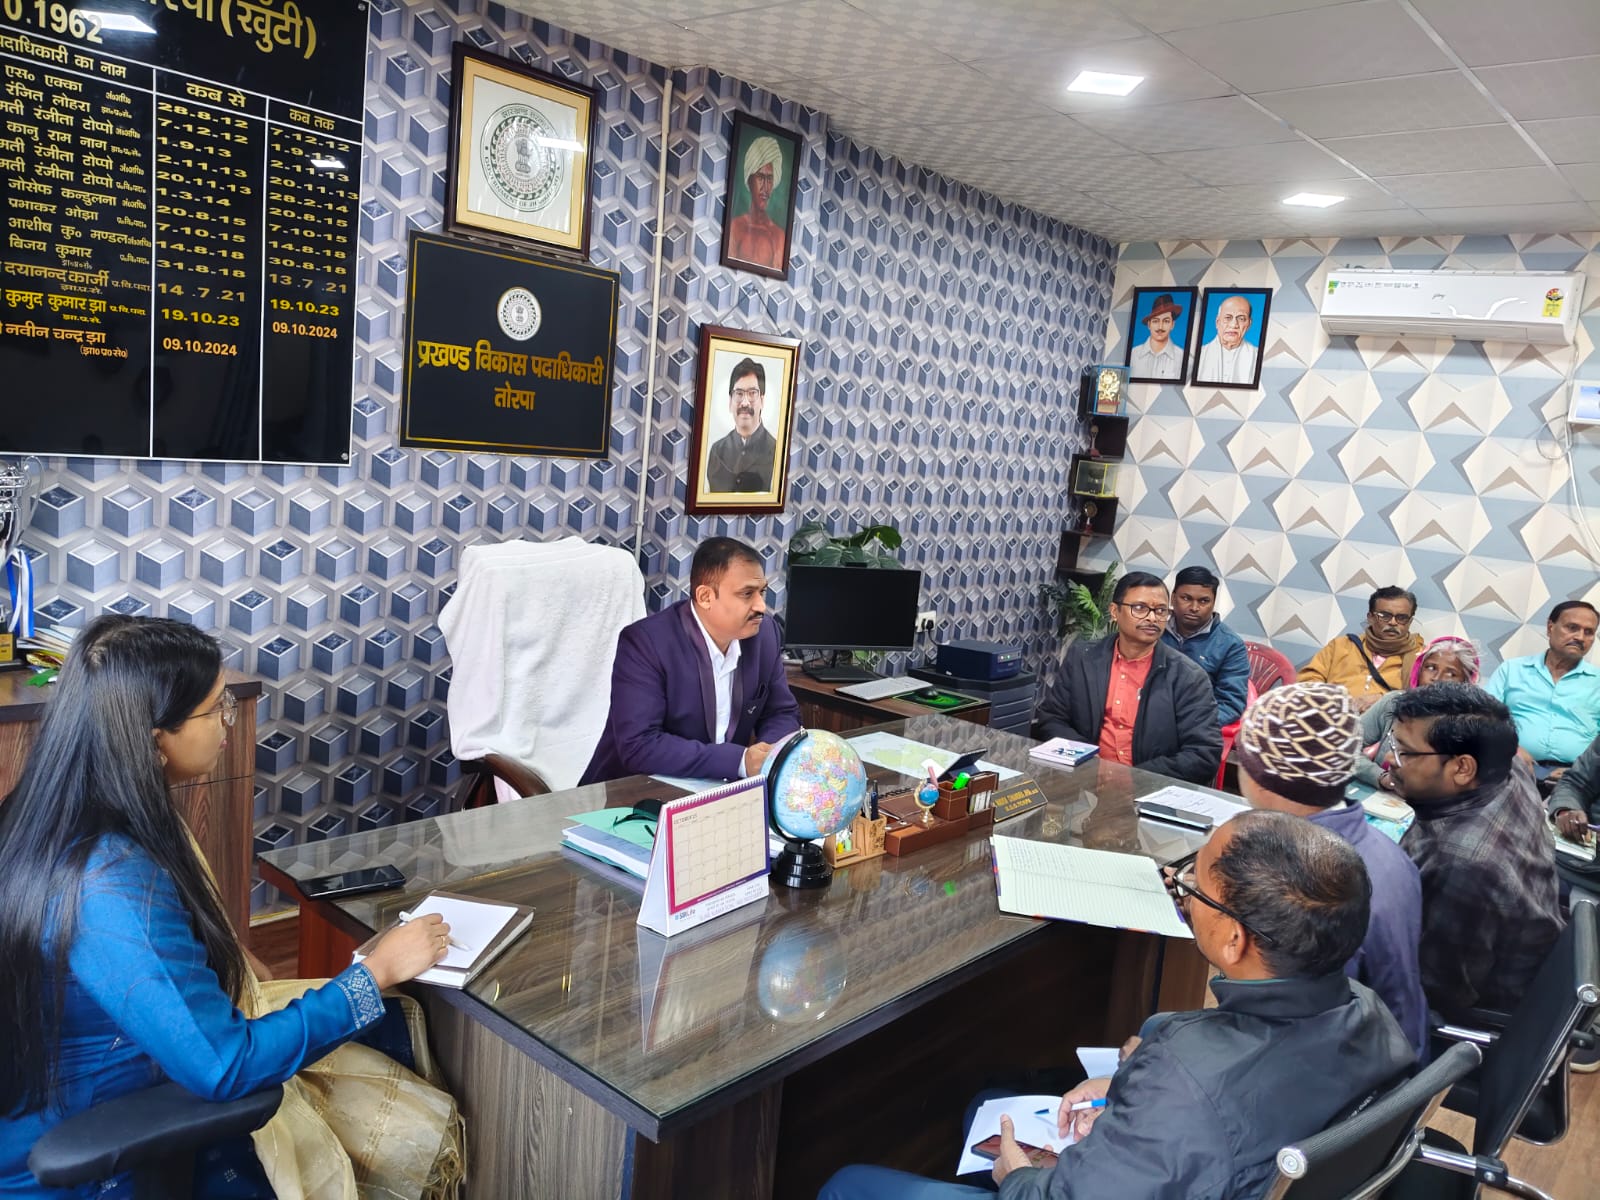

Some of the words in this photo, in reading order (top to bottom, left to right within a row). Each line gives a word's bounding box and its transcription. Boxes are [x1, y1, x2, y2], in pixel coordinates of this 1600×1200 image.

[74, 54, 94, 71] का
[100, 60, 126, 78] नाम
[44, 74, 83, 92] एक्का
[186, 82, 222, 103] कब
[228, 90, 246, 108] से
[5, 80, 44, 102] रंजित
[52, 93, 91, 112] लोहरा
[33, 105, 74, 126] रंजीता
[82, 116, 114, 135] टोप्पो
[158, 102, 248, 129] 28.8.12
[289, 108, 310, 125] कब
[314, 114, 335, 131] तक
[6, 121, 39, 141] कानु
[47, 129, 72, 143] राम
[80, 136, 107, 151] नाग
[158, 118, 248, 144] 7.12.12
[271, 127, 350, 152] 7.12.12
[34, 143, 74, 163] रंजीता
[82, 152, 114, 170] टोप्पो
[157, 137, 231, 157] 1.9.13
[34, 162, 74, 181] रंजीता
[82, 170, 114, 189] टोप्पो
[158, 154, 248, 178] 2.11.13
[271, 159, 350, 182] 2.11.13
[8, 176, 53, 195] जोसेफ
[157, 171, 252, 195] 20.11.13
[269, 176, 359, 200] 20.11.13
[8, 197, 58, 214] प्रभाकर
[65, 205, 99, 221] ओझा
[157, 188, 231, 207] 1.3.14
[269, 192, 349, 214] 28.2.14
[157, 205, 247, 226] 20.8.15
[269, 207, 348, 228] 20.8.15
[8, 216, 52, 233] आशीष
[90, 228, 128, 244] मण्डल
[156, 222, 246, 243] 7.10.15
[8, 233, 47, 252] विजय
[55, 243, 93, 258] कुमार
[156, 241, 245, 260] 14.8.18
[269, 240, 347, 259] 14.8.18
[4, 262, 67, 282] दयानन्द
[157, 260, 246, 278] 31.8.18
[268, 257, 347, 275] 30.8.18
[5, 289, 44, 309] कुमुद
[48, 293, 87, 311] कुमार
[89, 299, 107, 314] झा
[270, 299, 340, 317] 19.10.23
[161, 309, 240, 327] 19.10.23
[272, 321, 338, 339] 09.10.2024
[5, 320, 49, 339] नवीन
[53, 328, 84, 343] चन्द्र
[86, 331, 107, 345] झा
[163, 338, 239, 356] 09.10.2024
[417, 340, 472, 371] प्रखण्ड
[475, 339, 528, 376] विकास
[531, 351, 604, 385] पदाधिकारी
[494, 380, 536, 411] तोरपा
